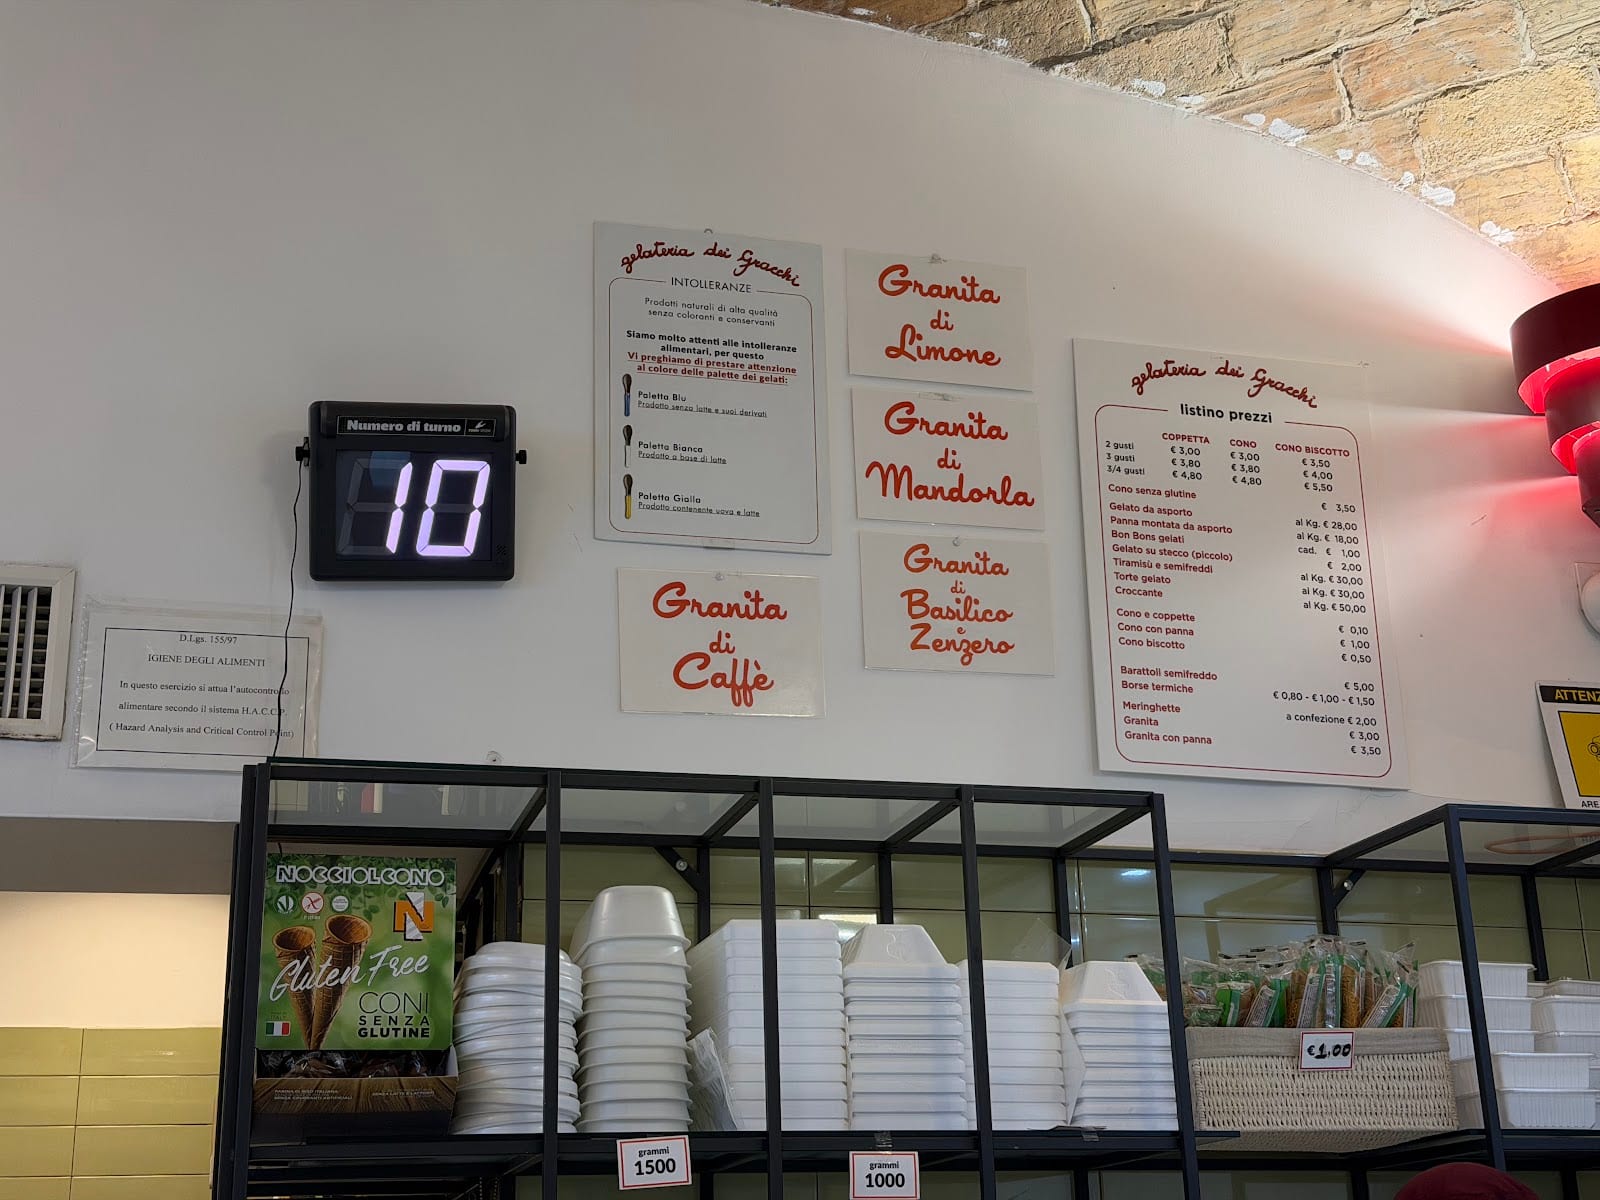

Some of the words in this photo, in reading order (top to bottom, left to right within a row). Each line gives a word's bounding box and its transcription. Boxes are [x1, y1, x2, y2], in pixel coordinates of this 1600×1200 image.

[621, 241, 695, 274] gelateria
[704, 242, 731, 258] dei
[733, 249, 800, 287] Gracchi
[671, 277, 752, 293] INTOLLERANZE
[878, 264, 1000, 304] Granita
[644, 297, 679, 308] Prodotti
[681, 302, 715, 312] naturali
[717, 303, 726, 313] di
[729, 304, 746, 314] alta
[748, 306, 778, 318] qualità
[648, 310, 674, 318] senza
[676, 311, 715, 321] coloranti
[726, 316, 775, 327] conservanti
[930, 309, 954, 331] di
[626, 330, 656, 340] Siamo
[658, 333, 686, 343] molto
[688, 335, 720, 346] attenti
[722, 338, 739, 348] alle
[741, 340, 797, 353] intolleranze
[885, 323, 1002, 366] Limone
[660, 343, 712, 356] alimentari,
[715, 349, 730, 359] per
[732, 350, 764, 361] questo
[627, 351, 639, 361] Vi
[641, 352, 692, 366] preghiamo
[694, 356, 704, 366] di
[706, 359, 745, 371] prestare
[747, 362, 797, 374] attenzione
[637, 363, 647, 372] al
[648, 364, 678, 375] colore
[681, 367, 704, 377] delle
[706, 369, 739, 381] palette
[742, 372, 757, 382] dei
[759, 373, 789, 385] gelati:
[1131, 360, 1207, 395] gelateria
[1215, 360, 1245, 378] dei
[1248, 368, 1318, 408] Gracchi
[638, 391, 669, 401] Paletta
[672, 393, 687, 402] Blu
[884, 401, 1009, 441] Granita
[1180, 403, 1224, 419] listino
[1229, 408, 1273, 425] prezzi
[347, 419, 404, 432] Numero
[406, 421, 421, 432] di
[423, 422, 461, 433] turno
[638, 441, 670, 451] Paletta
[673, 443, 703, 453] Bianca
[1105, 440, 1111, 448] 2
[1113, 441, 1134, 450] gusti
[1162, 432, 1210, 444] COPPETTA
[1230, 439, 1257, 448] CONO
[1275, 443, 1302, 453] CONO
[1305, 446, 1350, 457] BISCOTTO
[937, 448, 961, 470] di
[1114, 453, 1135, 463] gusti
[1106, 465, 1121, 473] 3/4
[1124, 466, 1145, 475] gusti
[865, 461, 1035, 507] Mandorla
[1108, 483, 1133, 493] Cono
[1135, 487, 1162, 496] senza
[1164, 488, 1197, 499] glutine
[638, 492, 670, 502] Paletta
[385, 459, 491, 557] 10
[743, 508, 760, 517] latte
[1109, 502, 1140, 512] Gelato
[1142, 504, 1154, 514] da
[1156, 506, 1193, 517] asporto
[1295, 518, 1303, 526] al
[1110, 516, 1139, 526] Panna
[1141, 519, 1180, 529] montata
[1183, 521, 1194, 531] da
[1197, 524, 1233, 534] asporto
[1111, 530, 1130, 539] Bon
[1132, 532, 1156, 541] Bons
[1158, 533, 1184, 544] gelati
[1298, 546, 1317, 555] cad.
[903, 543, 1010, 577] Granita
[1112, 543, 1143, 554] Gelato
[1145, 547, 1156, 555] su
[1158, 548, 1189, 558] stecco
[1191, 550, 1233, 562] (piccolo)
[1113, 557, 1153, 569] Tiramisù
[1163, 562, 1213, 574] semifreddi
[1114, 571, 1139, 581] Torte
[1141, 573, 1171, 584] gelato
[950, 579, 966, 595] di
[1115, 586, 1163, 597] Croccante
[652, 581, 788, 620] Granita
[900, 587, 1014, 624] Basilico
[1116, 608, 1141, 619] Cono
[1152, 611, 1196, 623] coppette
[956, 626, 967, 636] e
[1117, 622, 1143, 633] Cono
[1145, 625, 1163, 634] con
[1165, 626, 1194, 637] panna
[209, 635, 237, 645] 155/97
[709, 630, 736, 655] di
[910, 623, 1016, 666] Zenzero
[1118, 637, 1144, 648] Cono
[1146, 638, 1185, 650] biscotto
[148, 653, 182, 664] IGIENE
[184, 655, 215, 665] DEGLI
[217, 657, 265, 667] ALIMENTI
[672, 651, 775, 708] Caffè
[1120, 665, 1161, 678] Barattoli
[1164, 668, 1218, 681] semifreddo
[119, 680, 129, 689] In
[130, 682, 158, 692] questo
[160, 682, 197, 692] esercizio
[199, 683, 206, 692] si
[207, 685, 228, 693] attua
[230, 684, 290, 696] l'autocontrolo
[1121, 680, 1150, 692] Borse
[1152, 681, 1194, 694] termiche
[118, 702, 162, 711] alimentare
[165, 703, 199, 713] secondo
[200, 704, 207, 713] il
[208, 705, 239, 715] sistema
[1123, 701, 1181, 715] Meringhette
[1294, 711, 1345, 724] confezione
[116, 722, 146, 732] Hazard
[148, 724, 184, 735] Analysis
[186, 725, 201, 734] and
[203, 726, 234, 736] Critical
[236, 727, 267, 737] Control
[1123, 715, 1159, 727] Granita
[1124, 730, 1160, 742] Granita
[1162, 733, 1180, 743] con
[1183, 735, 1212, 746] panna
[276, 865, 445, 887] NOCCIOLCONO
[269, 955, 368, 1002] Gluten
[368, 945, 430, 987] Free
[359, 992, 429, 1014] CONI
[358, 1015, 430, 1026] SENZA
[357, 1027, 430, 1038] GLUTINE
[638, 1146, 670, 1158] grammi
[634, 1158, 676, 1176] 1500
[869, 1160, 900, 1171] grammi
[865, 1173, 906, 1188] 1000
